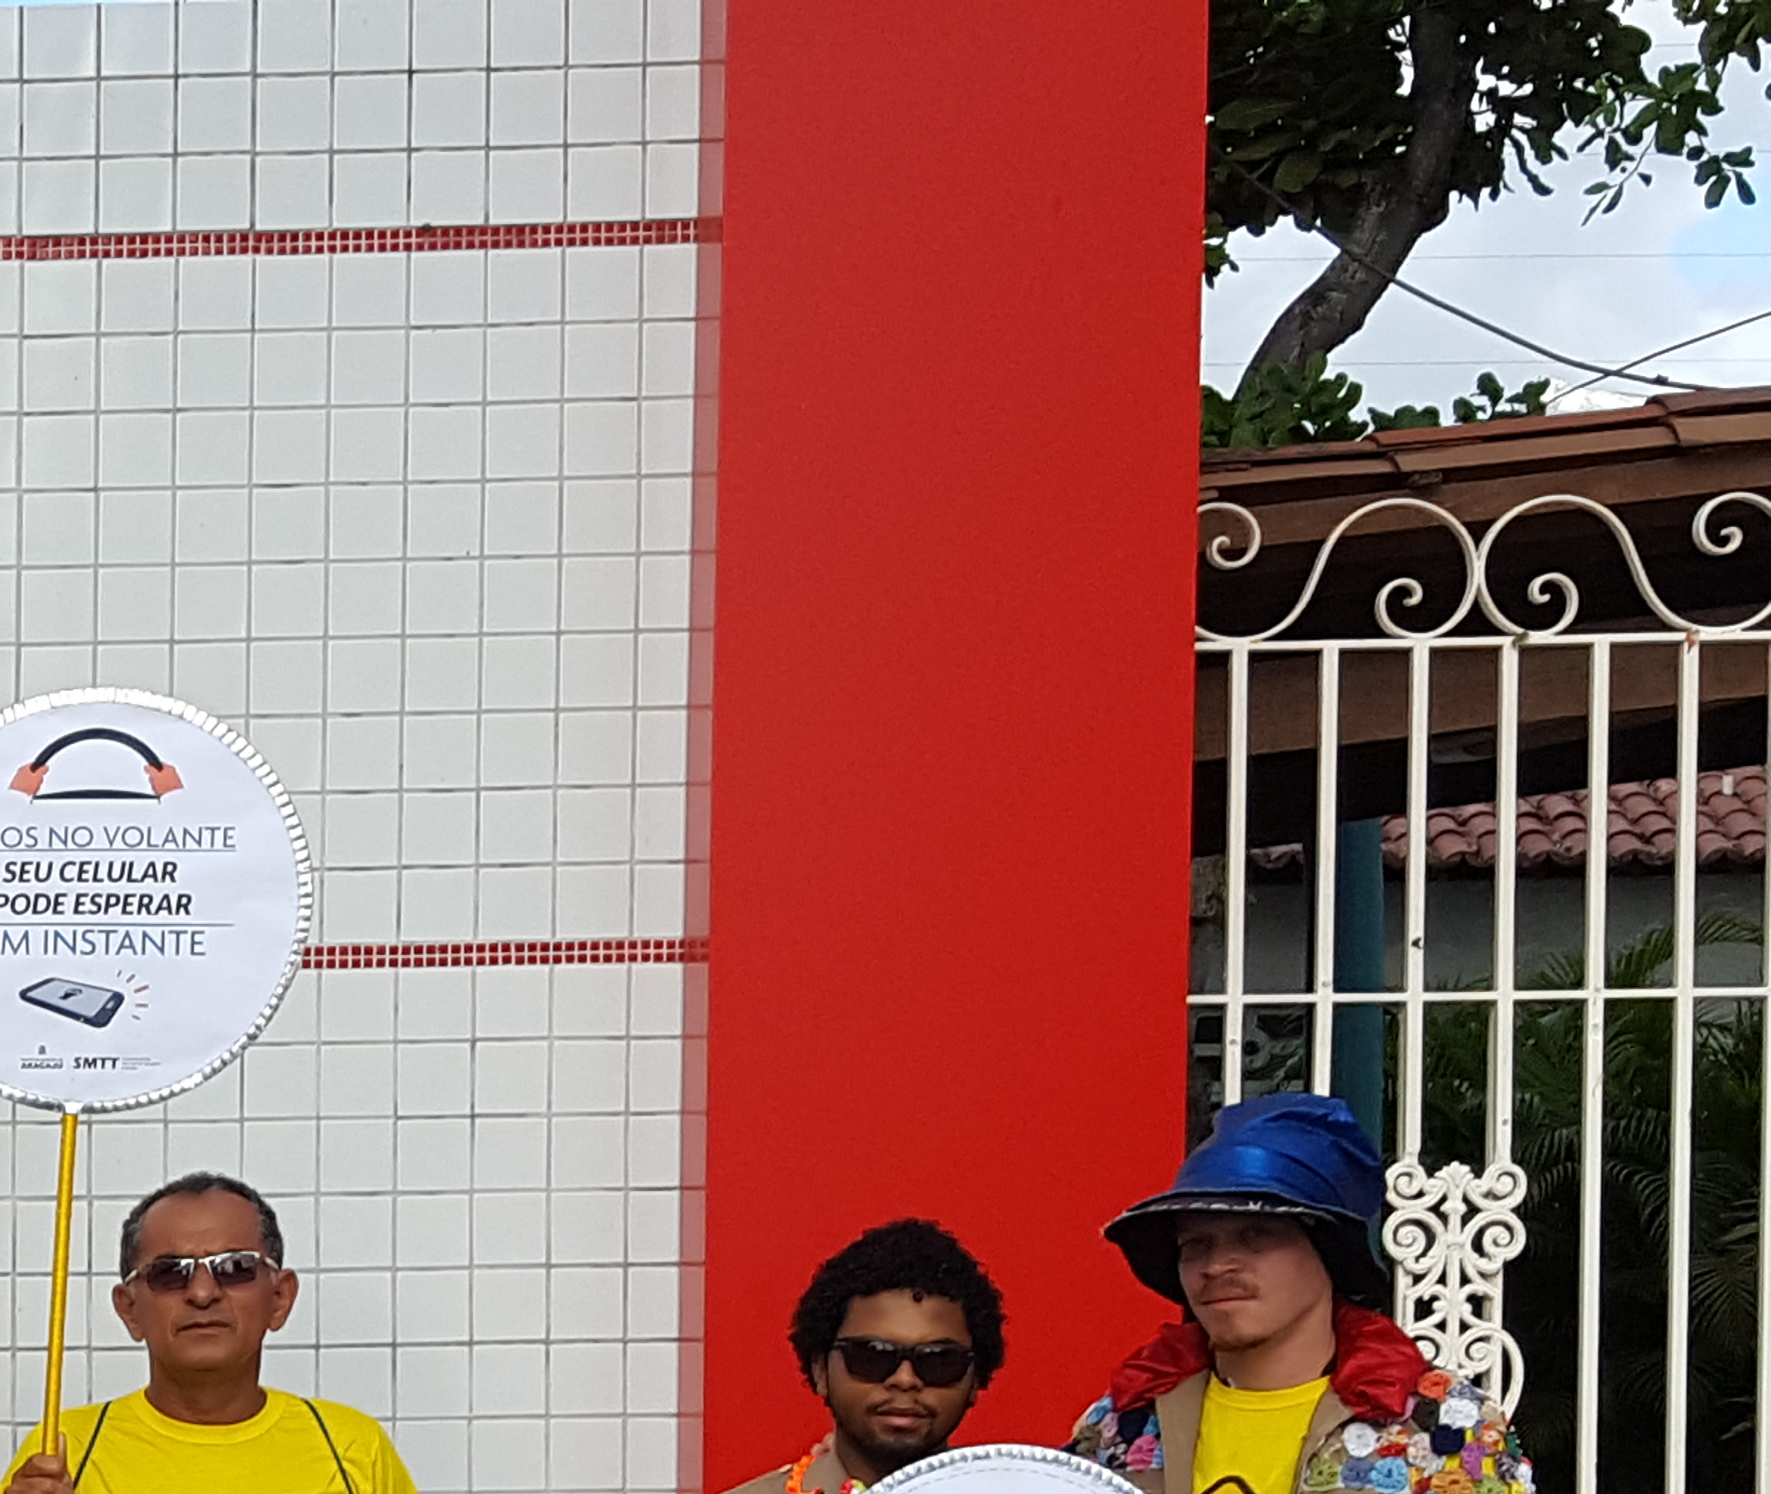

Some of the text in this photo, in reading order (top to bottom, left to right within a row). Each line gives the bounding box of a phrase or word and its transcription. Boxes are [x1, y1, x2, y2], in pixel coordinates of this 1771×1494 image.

[48, 827, 94, 848] NO
[103, 826, 236, 848] VOLANTE
[3, 861, 177, 883] SEU CELULAR
[73, 893, 191, 915] ESPERAR
[44, 930, 205, 956] INSTANTE
[73, 1057, 120, 1069] SMTT
